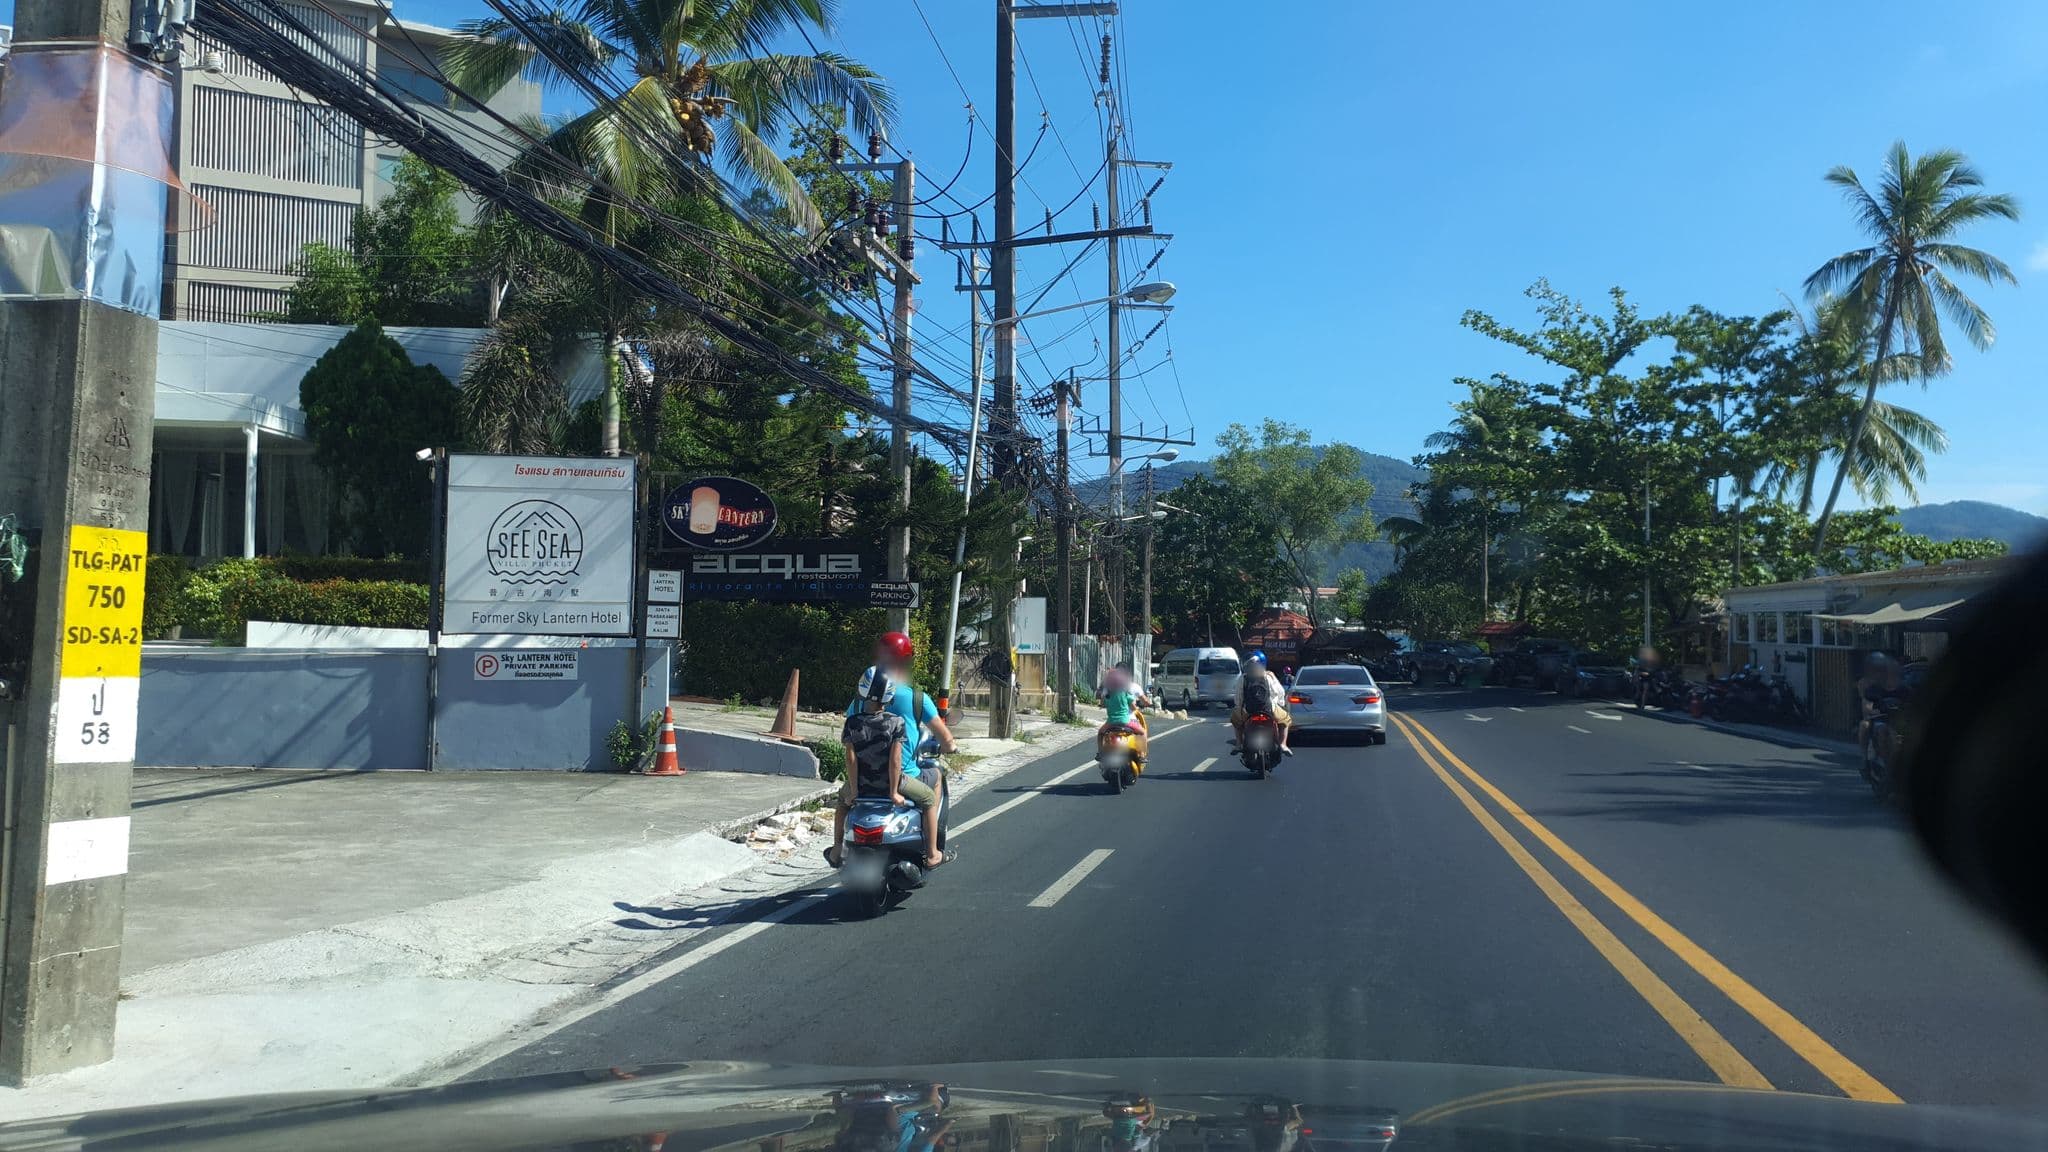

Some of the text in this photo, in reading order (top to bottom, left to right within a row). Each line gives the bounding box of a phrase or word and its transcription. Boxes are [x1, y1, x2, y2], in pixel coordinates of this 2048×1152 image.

[718, 507, 766, 527] LANTERN
[498, 529, 571, 560] SEE SEA
[72, 549, 142, 574] TLG-PAT
[532, 560, 573, 568] PHUKET
[692, 553, 862, 580] acqua
[654, 585, 675, 593] HOTEL
[870, 591, 911, 600] PARKING
[871, 583, 908, 591] acqua
[87, 584, 126, 610] 750
[472, 611, 622, 627] Former Sky Lantern Hotel
[67, 626, 138, 646] SD-SA-2
[1031, 643, 1041, 651] IN
[500, 653, 577, 664] Sky LANTERN HOTEL
[80, 722, 111, 746] 58
